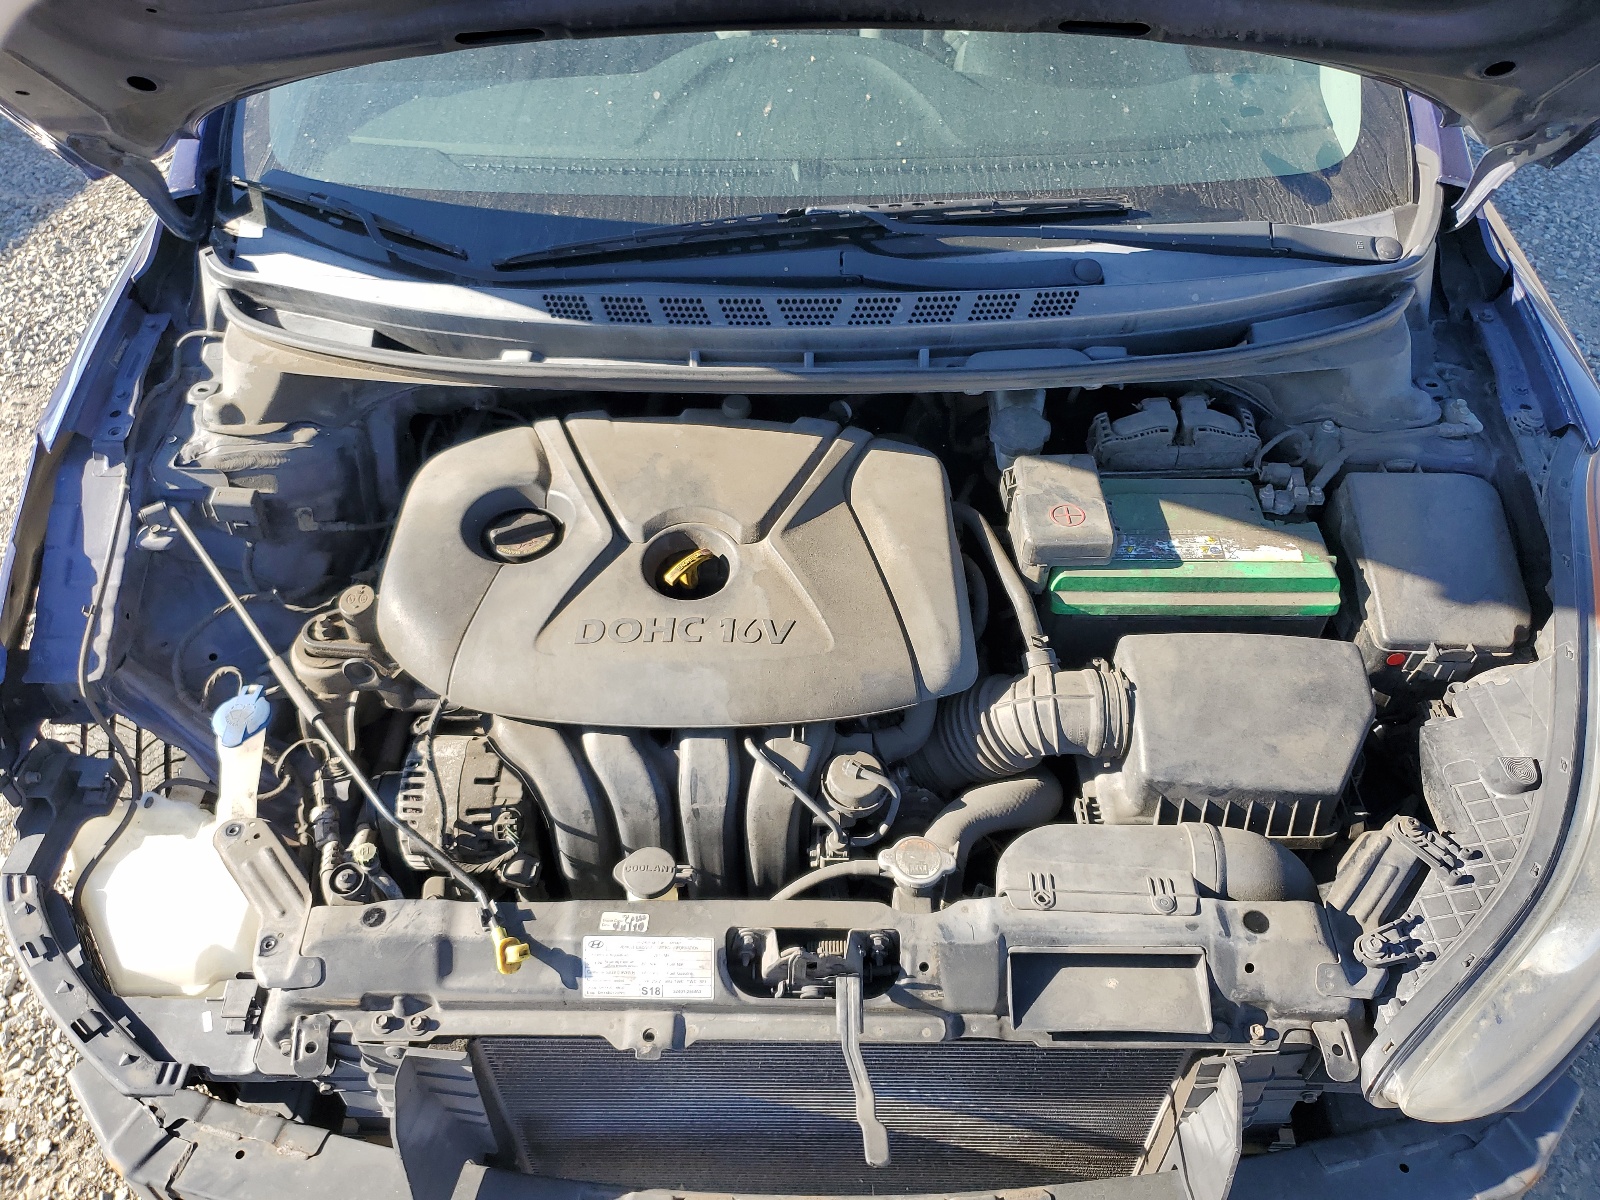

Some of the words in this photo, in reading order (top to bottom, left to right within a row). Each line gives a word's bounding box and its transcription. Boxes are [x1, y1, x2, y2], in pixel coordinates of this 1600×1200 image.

[574, 617, 705, 644] DOHC
[720, 618, 797, 644] 16V
[625, 864, 675, 873] COOLANT
[641, 986, 661, 996] S18
